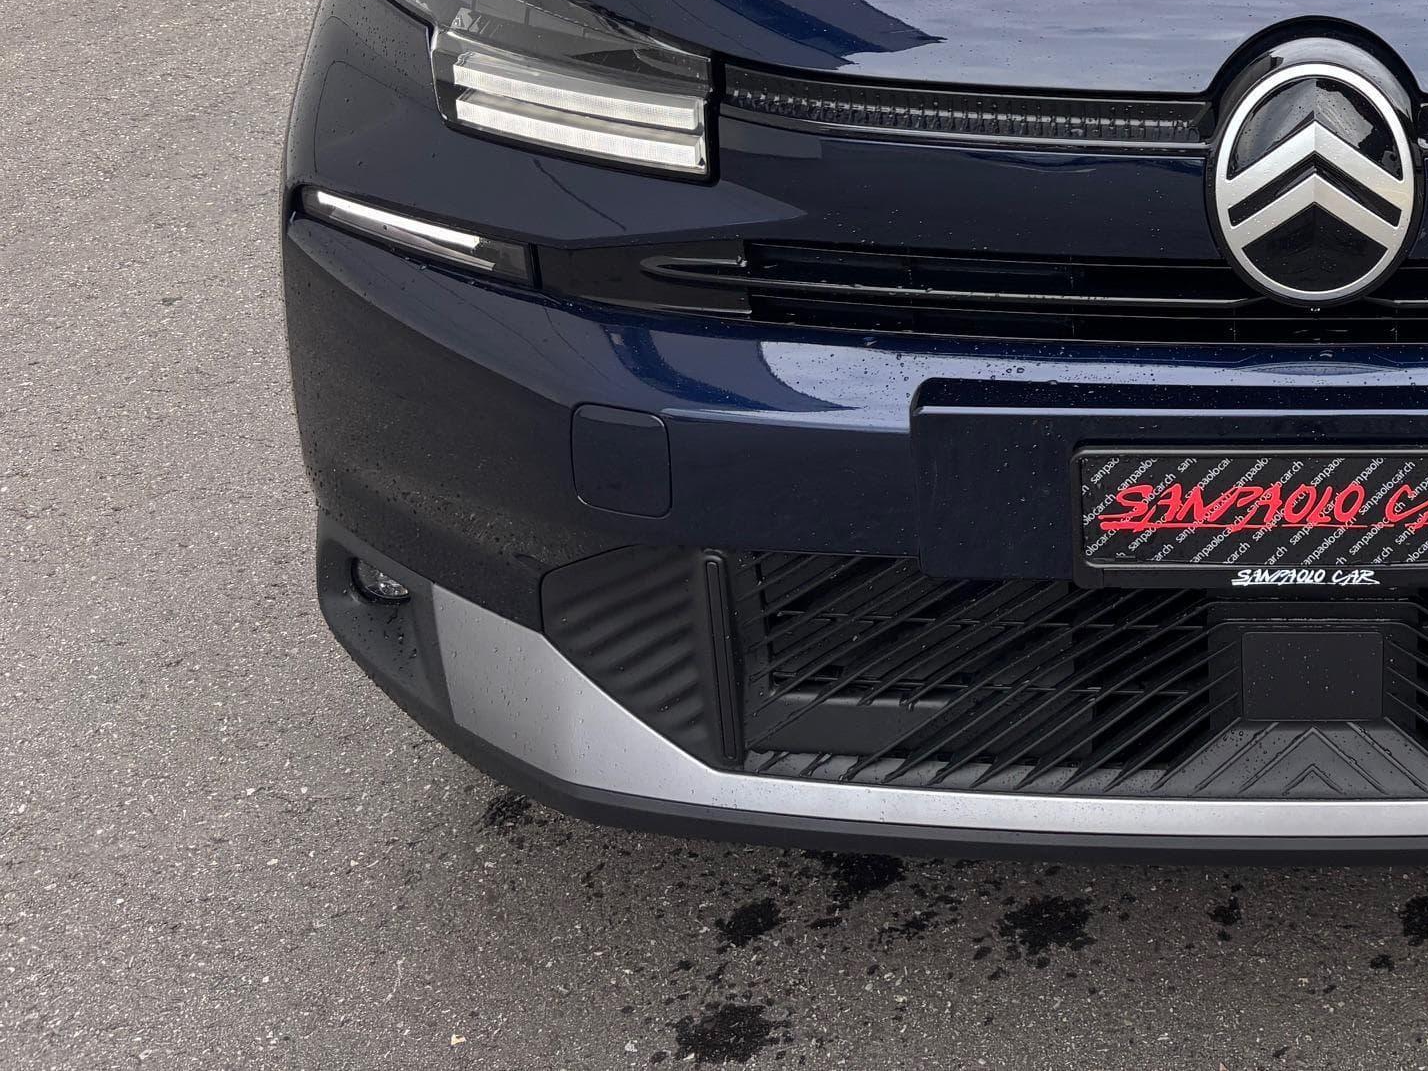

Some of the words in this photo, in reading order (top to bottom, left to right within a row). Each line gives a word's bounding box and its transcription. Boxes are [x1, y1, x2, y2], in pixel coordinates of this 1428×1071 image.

[1098, 482, 1366, 533] SANPAOLO
[1231, 568, 1326, 586] SANPAOLO
[1331, 569, 1381, 586] CAR
